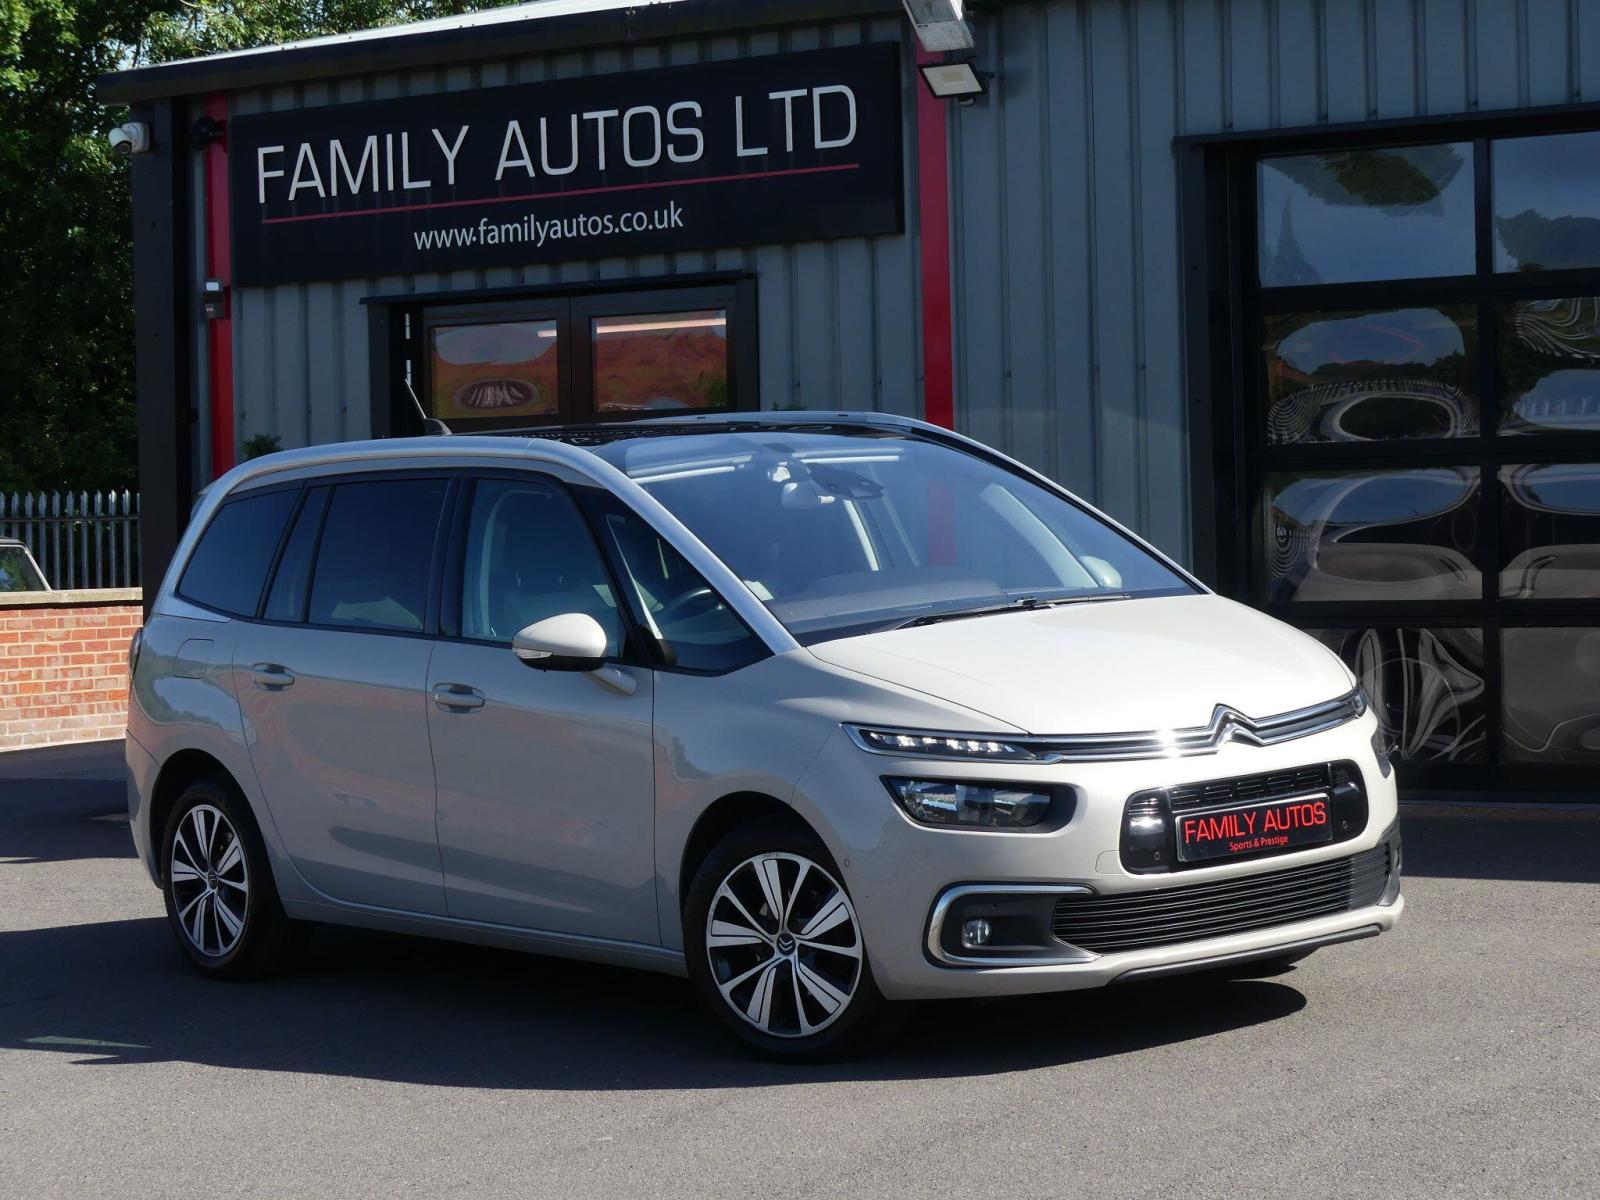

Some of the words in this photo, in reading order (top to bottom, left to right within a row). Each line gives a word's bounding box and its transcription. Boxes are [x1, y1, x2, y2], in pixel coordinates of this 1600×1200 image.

[257, 125, 470, 204] FAMILY
[494, 101, 703, 181] AUTOS
[734, 84, 857, 157] LTD
[413, 200, 684, 250] www.familyautos.co.uk
[1184, 811, 1256, 844] FAMILY
[1263, 801, 1327, 831] AUTOS
[1229, 840, 1253, 852] Sports
[1260, 835, 1289, 847] Prestige
